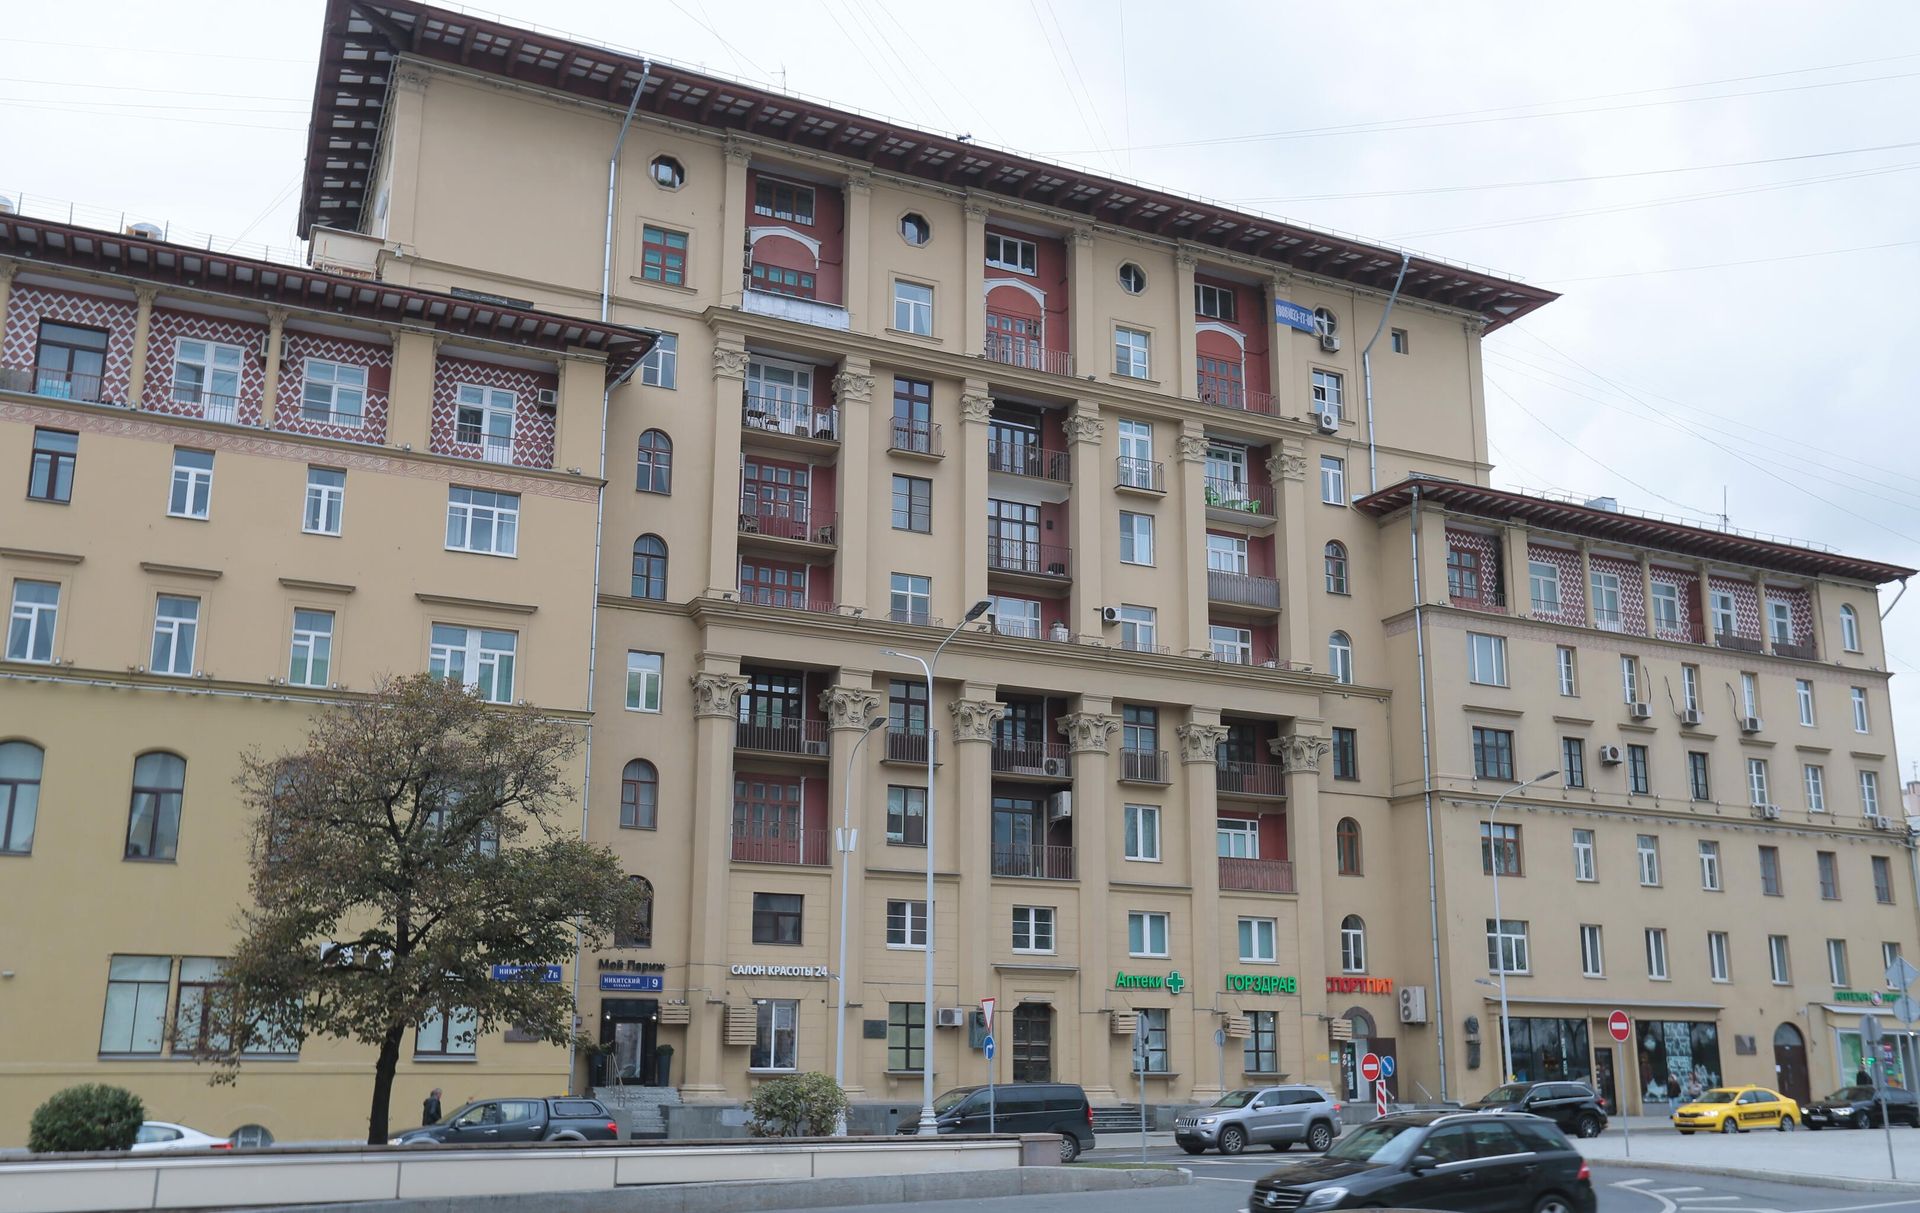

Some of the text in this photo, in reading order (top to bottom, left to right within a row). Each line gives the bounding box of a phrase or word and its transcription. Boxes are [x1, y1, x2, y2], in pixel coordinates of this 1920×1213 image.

[598, 959, 665, 973] Мой Париж
[731, 964, 828, 977] САЛОН КРАСОТЫ 24
[603, 976, 641, 984] НИКИТСКИЙ
[652, 978, 659, 988] 9
[1115, 971, 1165, 988] Аптеки
[1226, 974, 1297, 994] ГОРЗДРАВ
[1326, 976, 1393, 993] СПОРТПИТ
